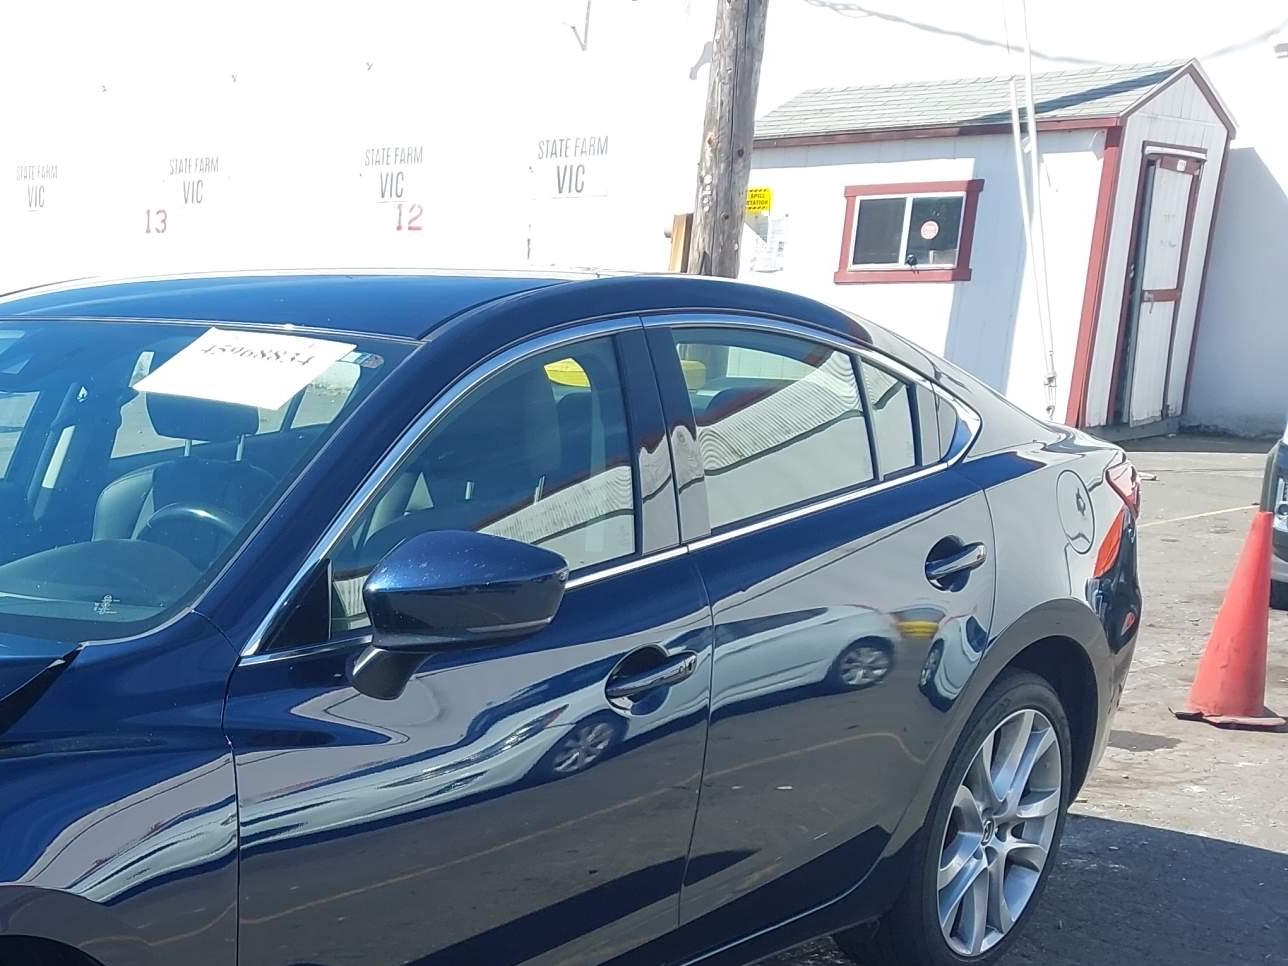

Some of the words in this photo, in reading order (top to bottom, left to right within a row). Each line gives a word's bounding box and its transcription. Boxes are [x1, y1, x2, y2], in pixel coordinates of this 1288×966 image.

[364, 147, 391, 167] STATE
[394, 145, 424, 165] FARM
[538, 138, 571, 160] STATE
[574, 135, 609, 157] FARM
[169, 158, 192, 176] STATE
[194, 156, 219, 174] FARM
[556, 163, 586, 195] VIC
[27, 183, 45, 208] VIC
[183, 179, 204, 205] VIC
[379, 170, 405, 199] VIC
[144, 208, 168, 234] 13
[395, 203, 424, 231] 12
